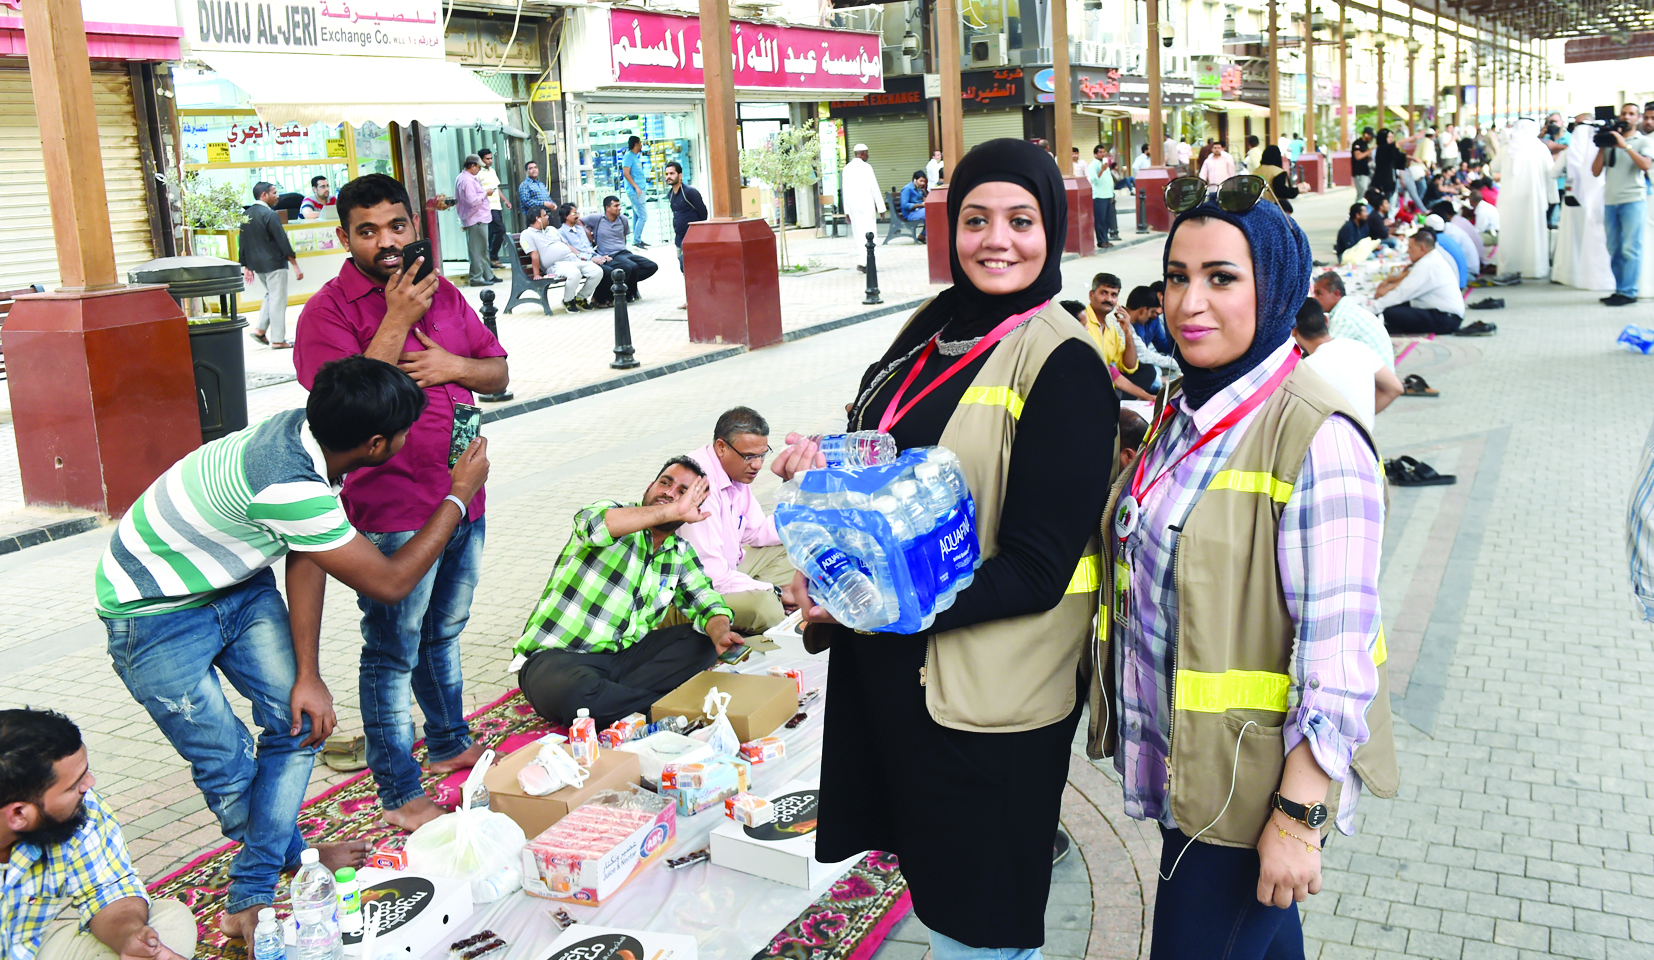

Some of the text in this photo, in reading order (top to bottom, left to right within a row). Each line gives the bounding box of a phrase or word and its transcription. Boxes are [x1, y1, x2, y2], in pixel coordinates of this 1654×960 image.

[197, 0, 318, 46] DUAIJ AL-JERI
[320, 0, 436, 24] للصيرفة
[320, 26, 372, 47] Exchange
[375, 29, 391, 45] Co.
[747, 32, 779, 74] الله
[784, 46, 817, 82] عبد
[821, 42, 880, 84] مؤسسة
[993, 68, 1023, 80] شركة
[870, 91, 921, 106] EXCHANGE
[975, 83, 1016, 103] السفير
[645, 831, 663, 849] ABC
[603, 866, 616, 881] Juice
[620, 851, 638, 867] Nectar
